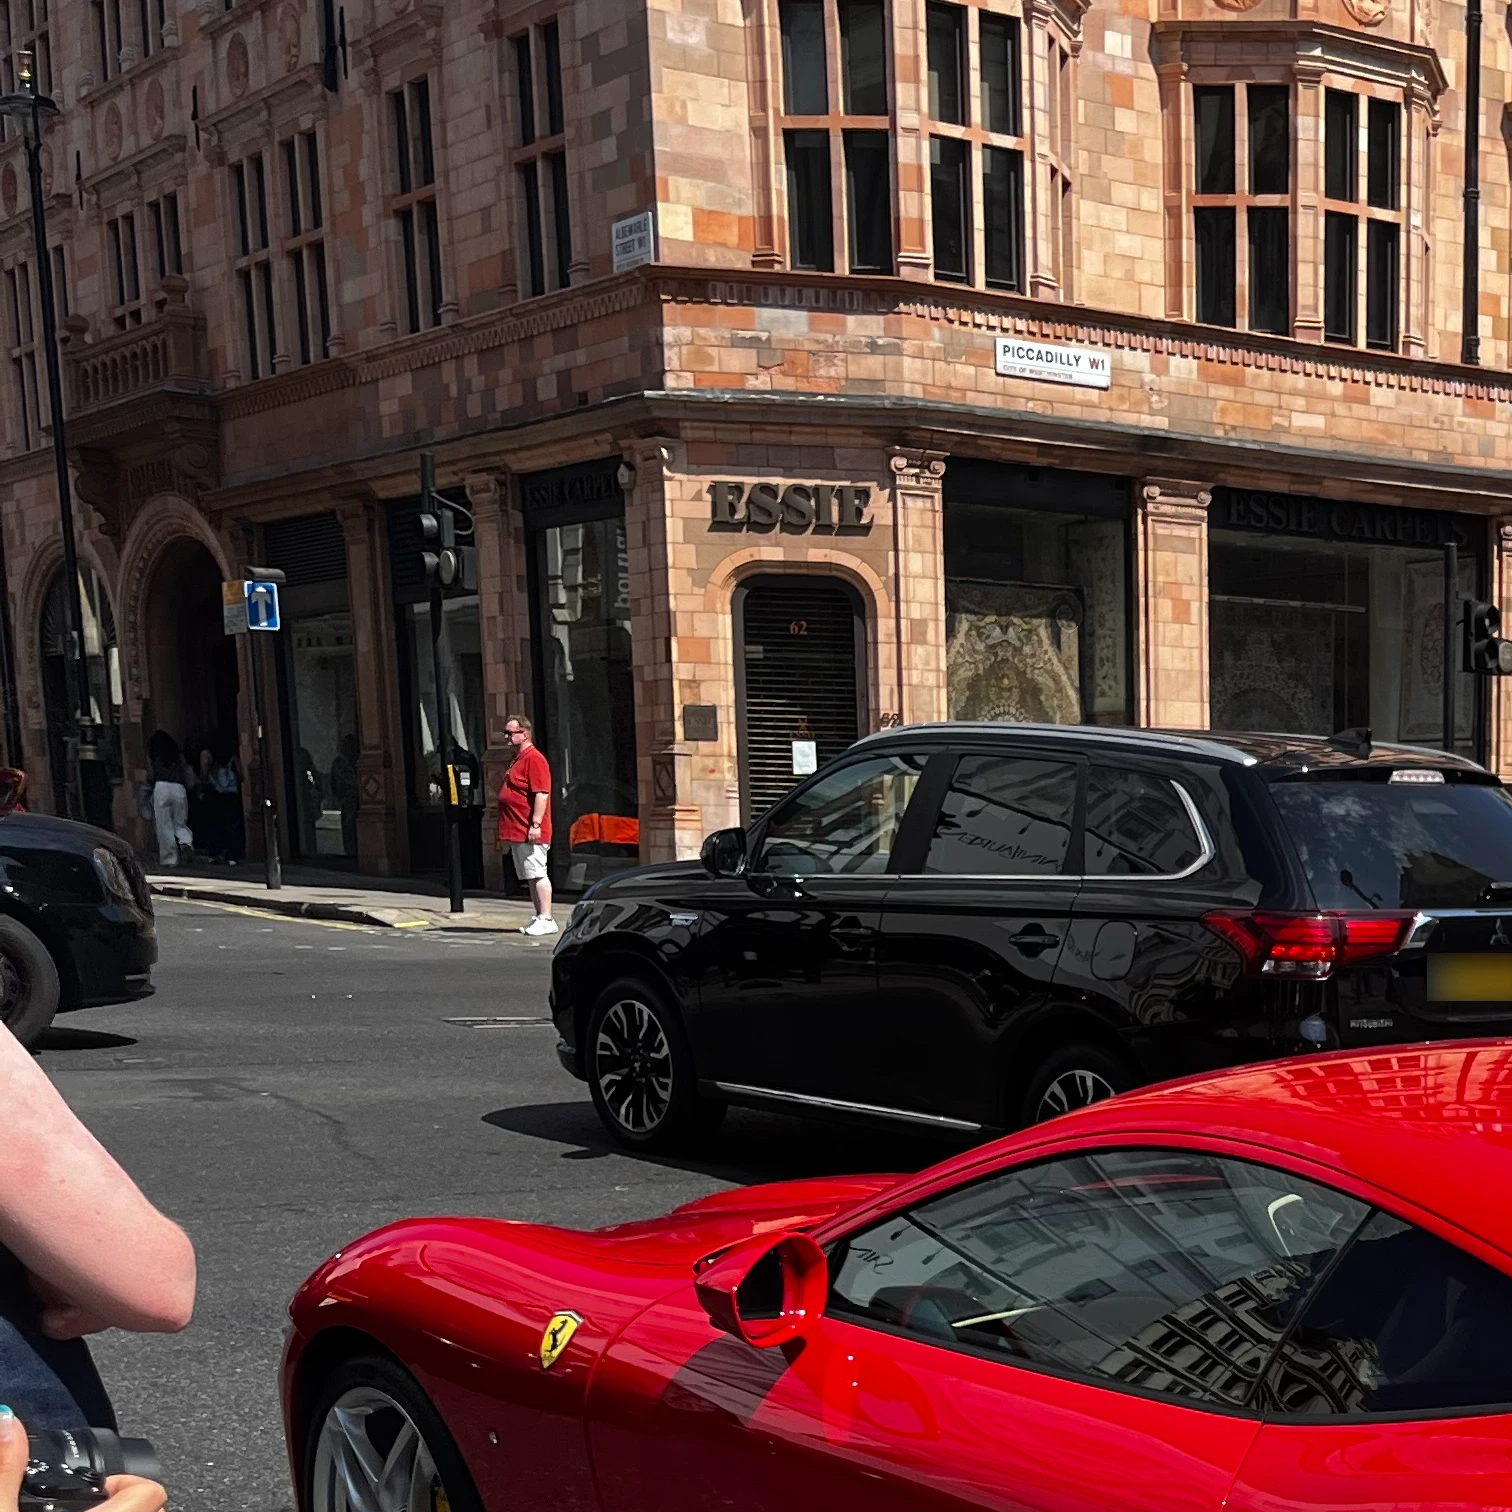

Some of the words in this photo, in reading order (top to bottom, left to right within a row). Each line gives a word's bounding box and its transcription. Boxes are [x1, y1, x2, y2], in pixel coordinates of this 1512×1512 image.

[1003, 345, 1081, 367] PICCADILLY
[1088, 356, 1105, 371] W1
[707, 480, 875, 534] ESSIE
[1228, 493, 1319, 533] ESSIE
[1330, 503, 1468, 546] CARPETS
[789, 621, 808, 635] 62
